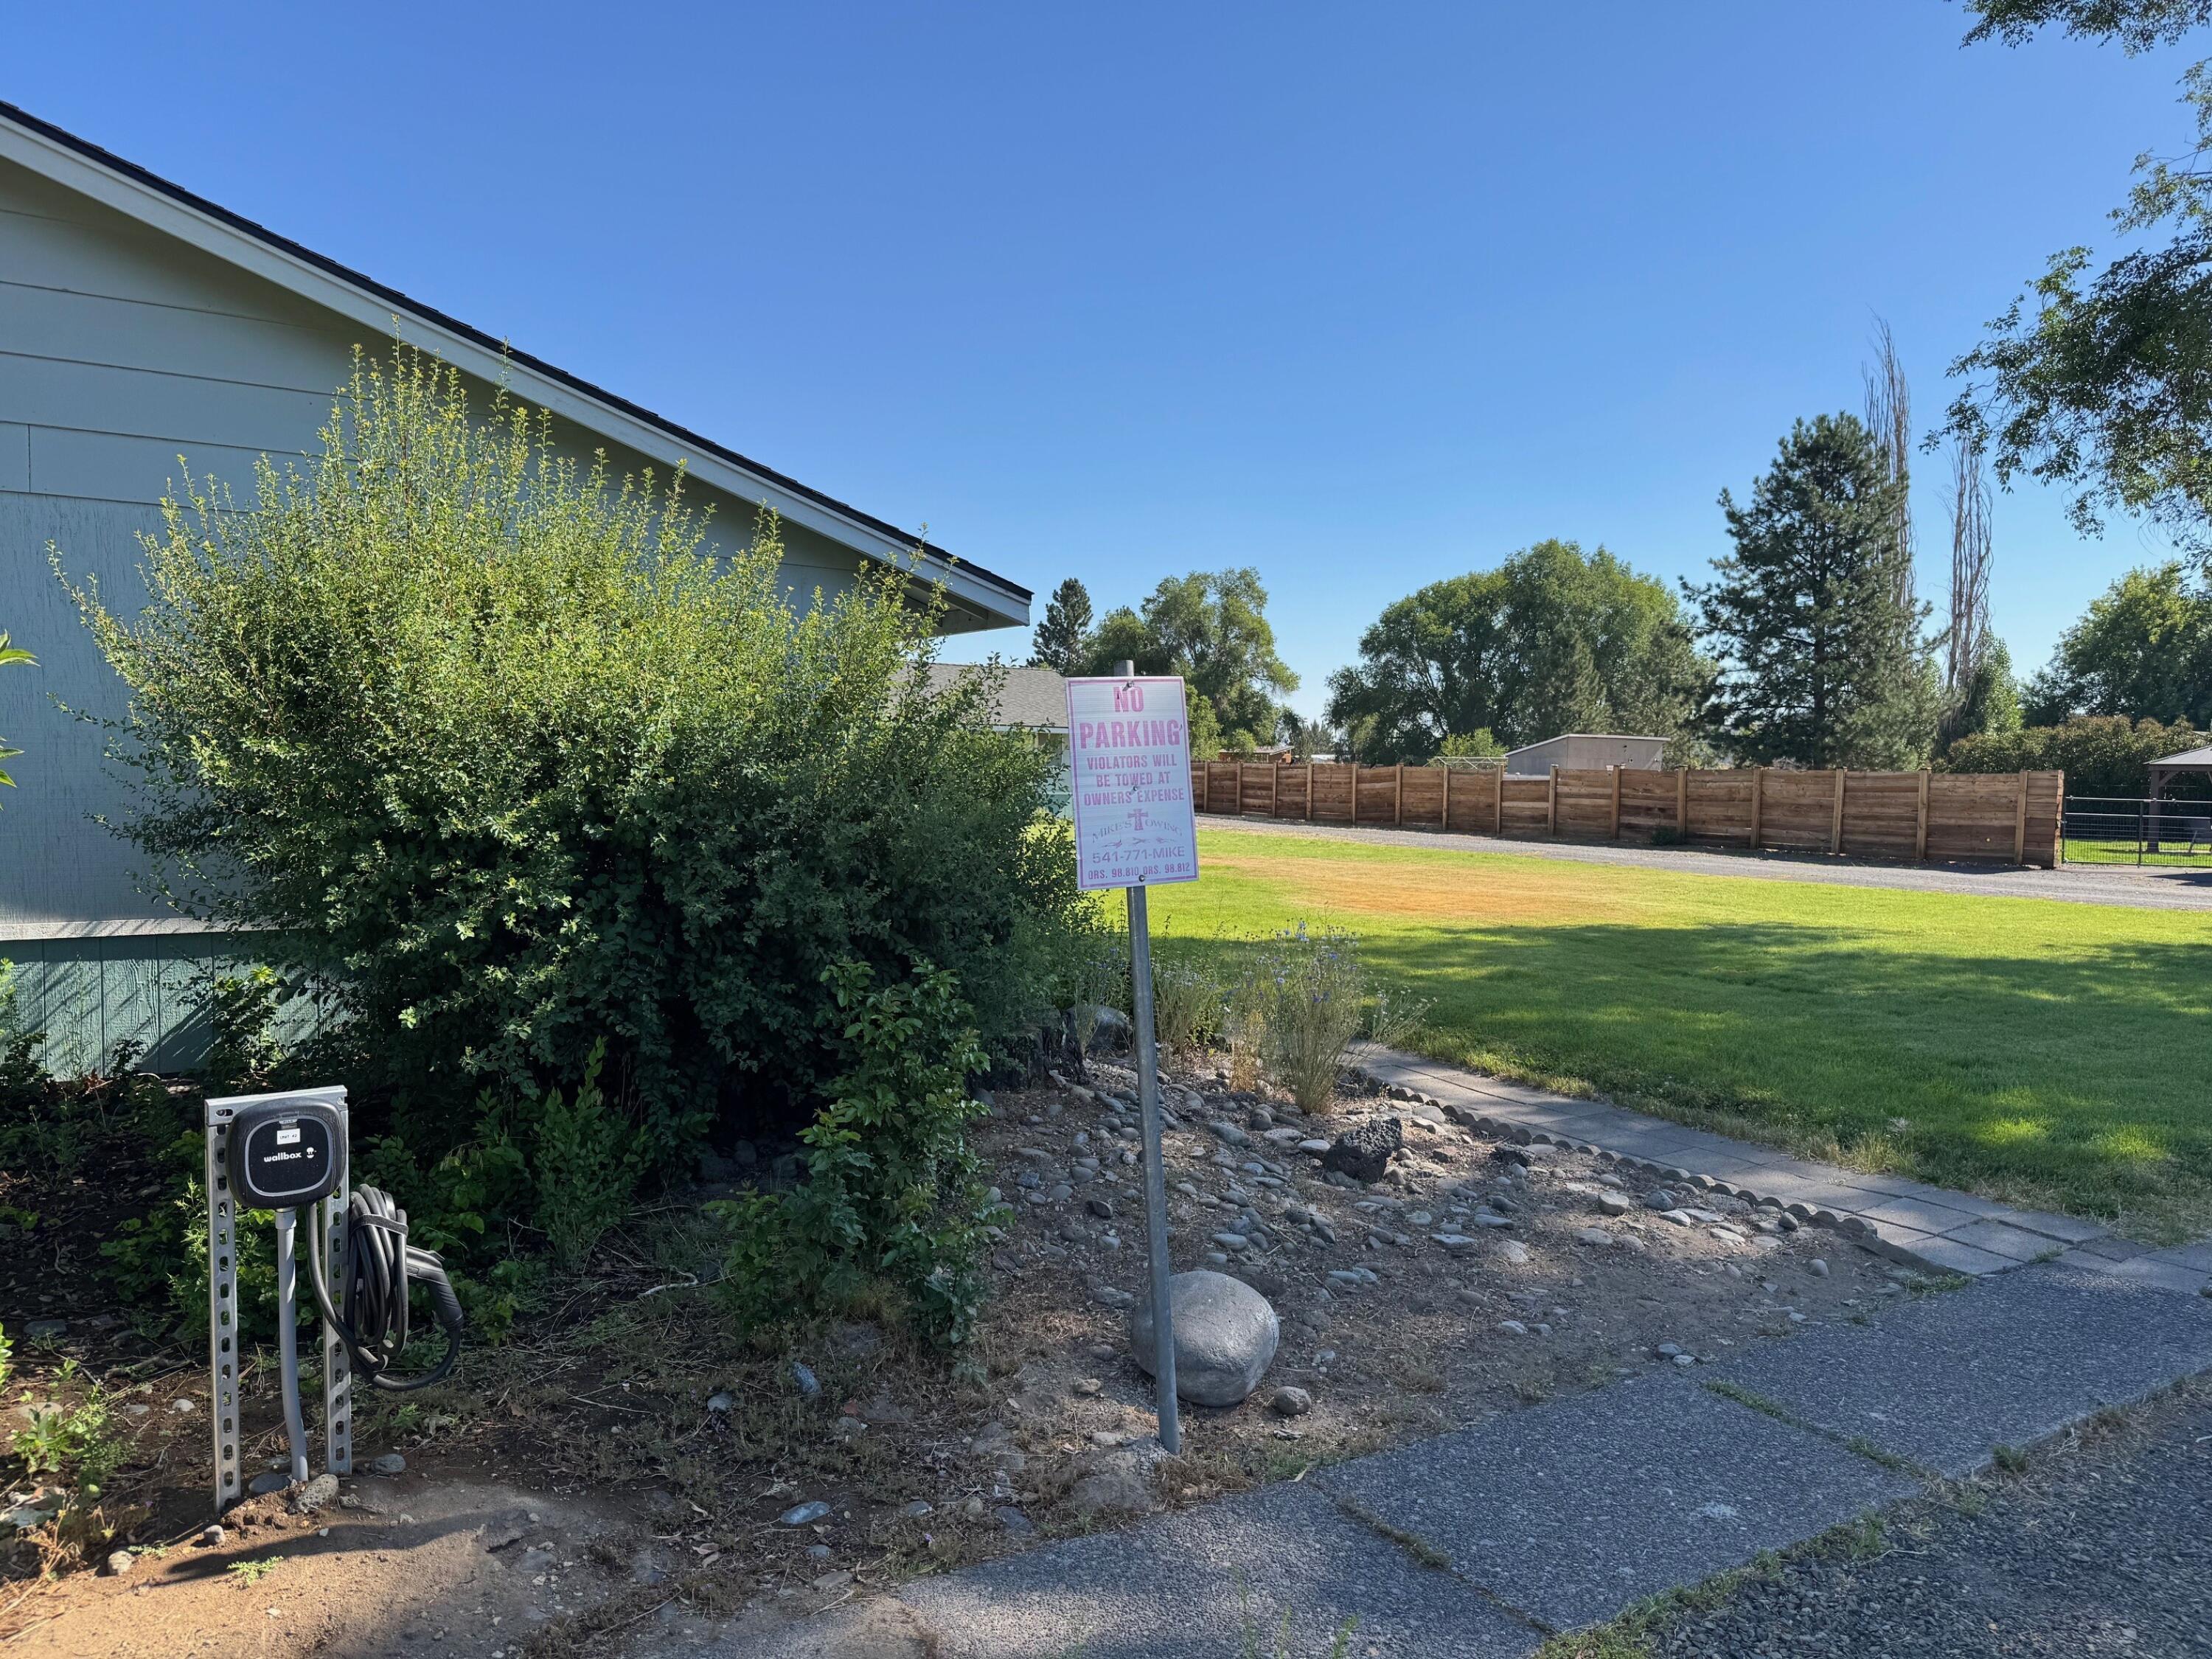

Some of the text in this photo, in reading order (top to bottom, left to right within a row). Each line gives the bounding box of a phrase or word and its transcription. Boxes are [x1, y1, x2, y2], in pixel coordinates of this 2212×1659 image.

[1113, 686, 1144, 712] NO
[1079, 720, 1180, 748] PARKING
[1087, 753, 1177, 771] VIOLATORS WILL
[1096, 771, 1171, 787] BE TOWED AT
[1084, 788, 1185, 806] OWNERS EXPENSE
[1092, 819, 1133, 844] MIKE'S
[1092, 846, 1185, 863] 541-771-MIKE
[1088, 862, 1190, 880] ORS. 98.810 ORS. 98.812
[264, 1152, 302, 1162] wallbox
